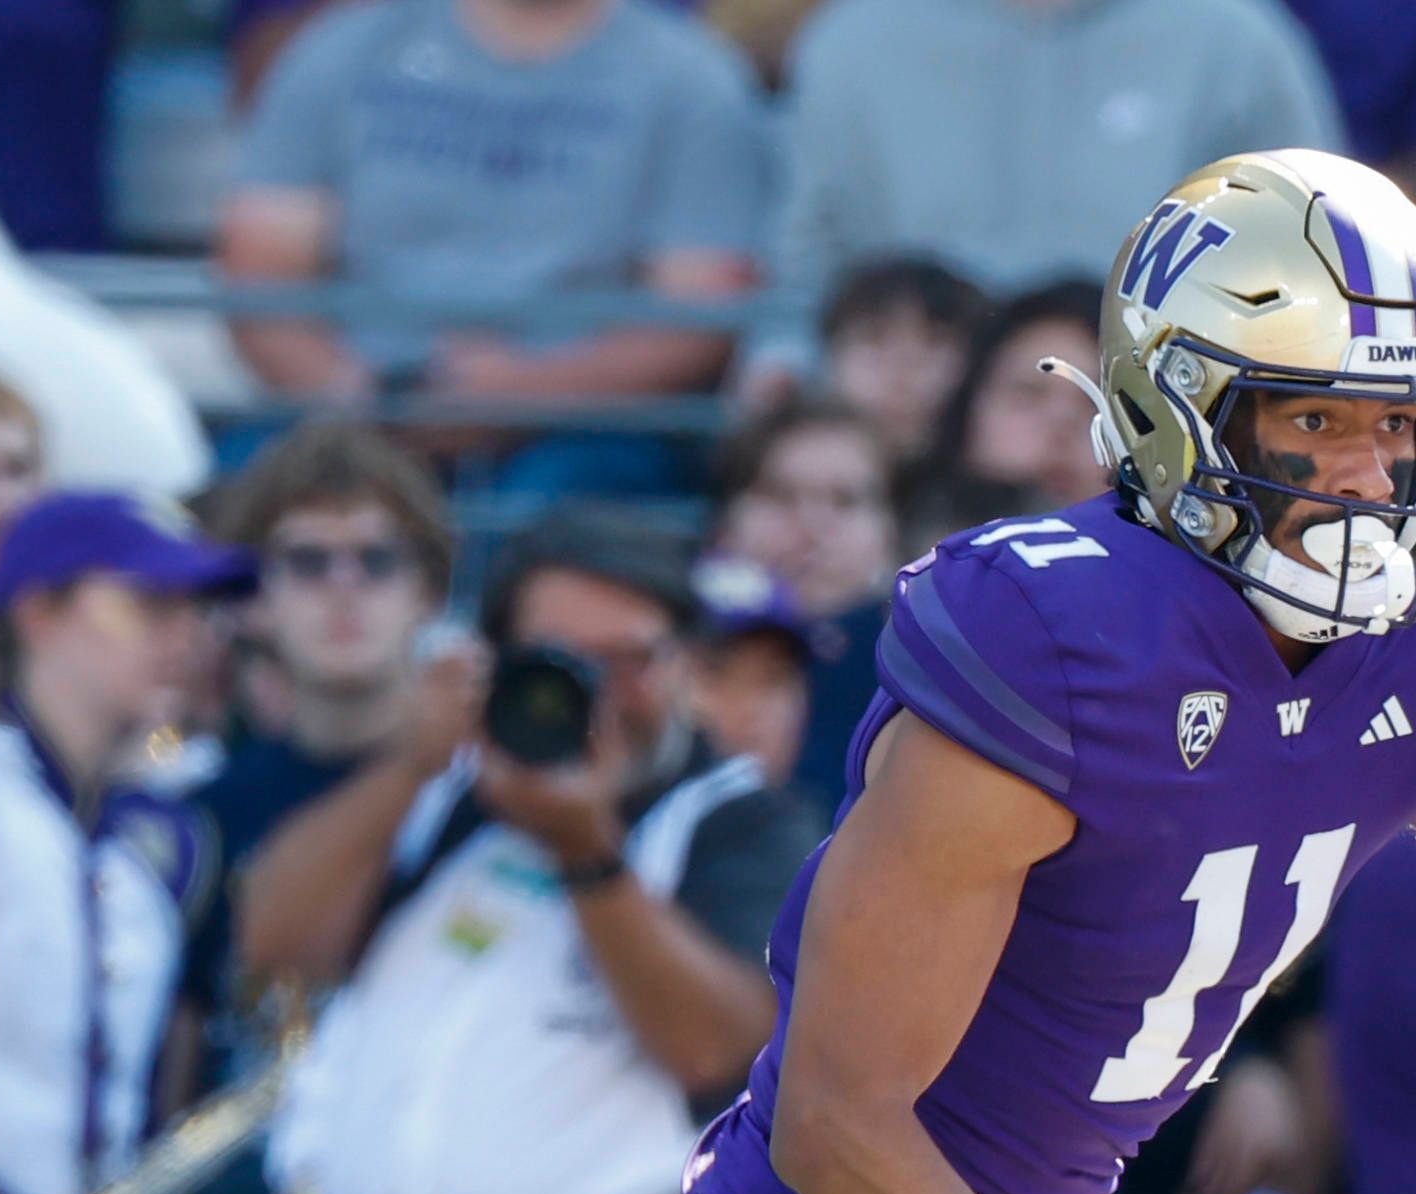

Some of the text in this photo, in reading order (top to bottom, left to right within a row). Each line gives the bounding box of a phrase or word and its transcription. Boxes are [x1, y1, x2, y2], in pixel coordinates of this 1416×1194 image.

[1118, 200, 1237, 311] W
[969, 518, 1110, 569] 11
[1276, 697, 1311, 737] W
[1088, 822, 1357, 1103] 11
